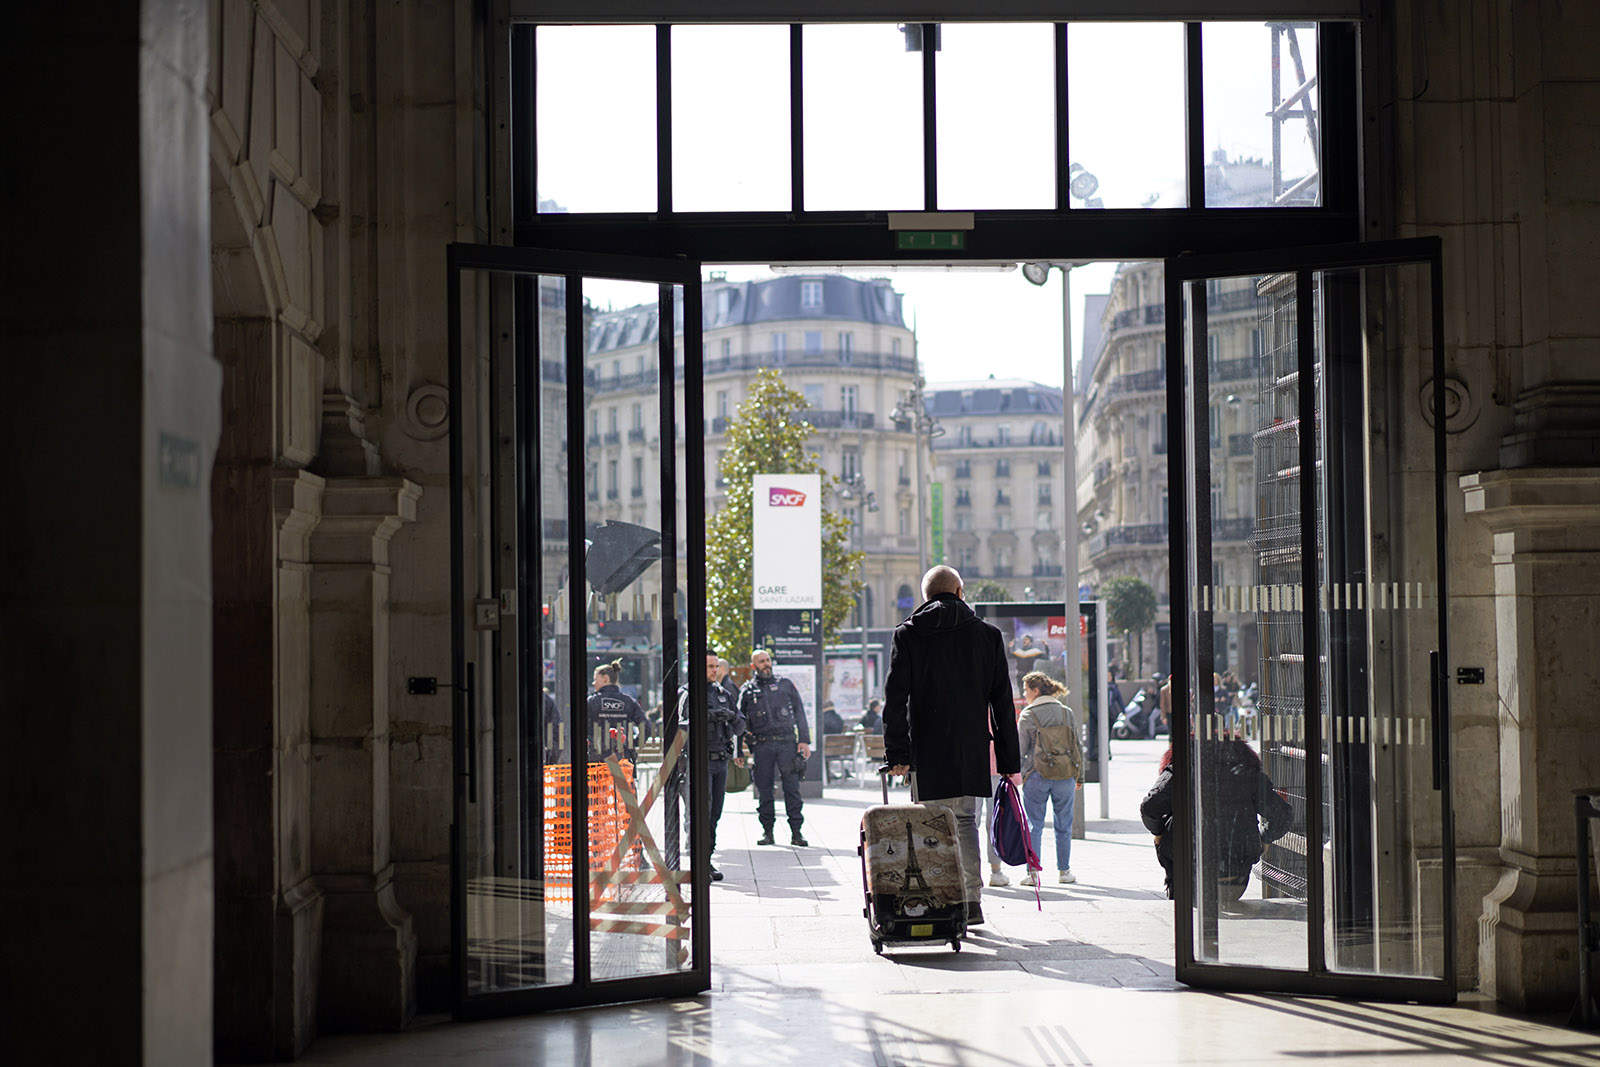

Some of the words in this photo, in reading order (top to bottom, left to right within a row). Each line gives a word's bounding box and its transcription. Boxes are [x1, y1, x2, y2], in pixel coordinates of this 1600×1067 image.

[771, 494, 804, 505] SNCF
[758, 586, 787, 595] GARE
[759, 595, 815, 604] SAINT-LAZARE
